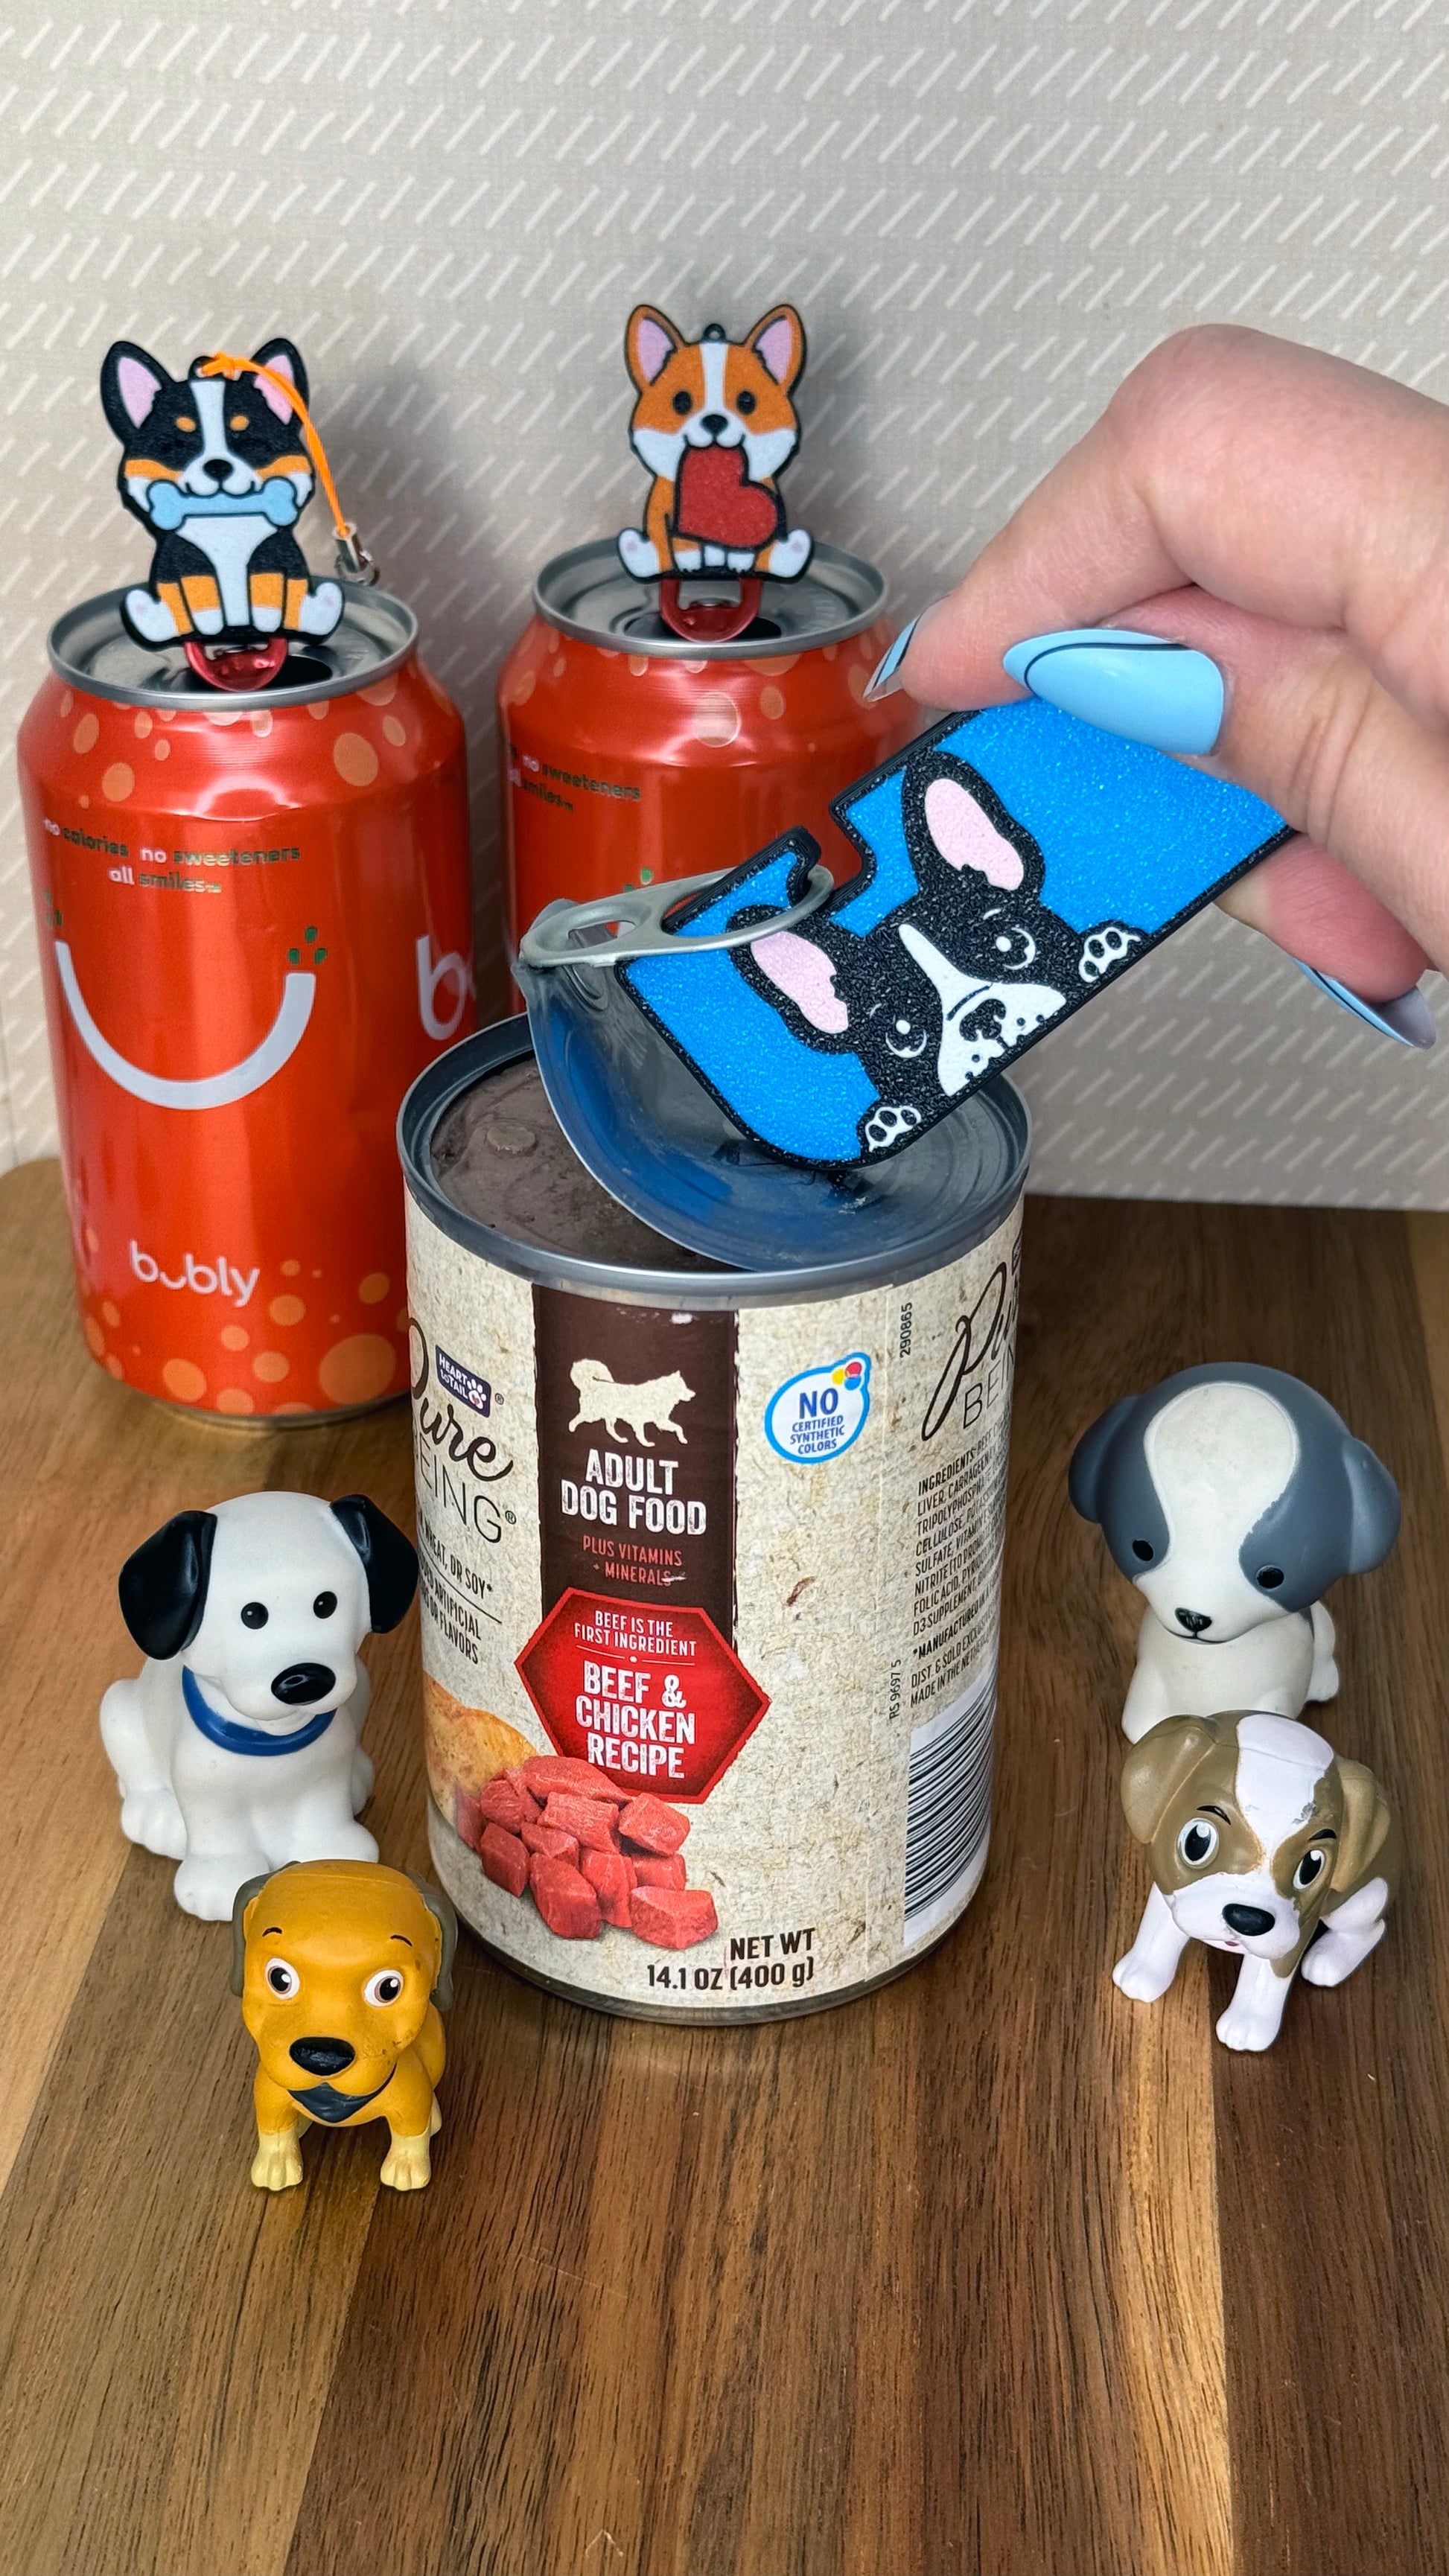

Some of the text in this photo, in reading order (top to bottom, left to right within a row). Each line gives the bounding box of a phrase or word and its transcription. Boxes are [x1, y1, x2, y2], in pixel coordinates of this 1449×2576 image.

[542, 765, 641, 801] sweeteners
[63, 828, 128, 857] calories
[140, 847, 167, 863] no
[173, 847, 299, 867] sweeteners
[108, 864, 135, 885] all
[899, 1302, 913, 1359] 290865
[439, 1353, 468, 1384] HEART
[799, 1388, 838, 1420] NO
[789, 1424, 845, 1445] SYNTHETIC
[792, 1415, 844, 1432] CERTIFIED
[797, 1438, 837, 1455] COLORS
[585, 1448, 679, 1495] ADULT
[561, 1479, 707, 1535] DOG FOOD
[917, 1490, 946, 1517] LIVER,
[583, 1534, 683, 1566] PLUS VITAMINS
[450, 1554, 462, 1584] OR
[605, 1561, 672, 1587] MINERALS
[914, 1564, 949, 1597] NITRITE
[434, 1577, 481, 1641] ARTIFICIAL
[914, 1590, 939, 1617] FOLIC
[439, 1610, 479, 1665] FLAVORS
[574, 1622, 697, 1657] FIRST INGREDIENT
[595, 1610, 673, 1638] BEEF IS THE
[913, 1617, 926, 1636] D3
[942, 1642, 961, 1668] SOLD
[584, 1660, 687, 1709] BEEF &
[890, 1672, 901, 1701] 9697
[911, 1680, 936, 1709] MADE
[937, 1672, 946, 1692] IN
[947, 1660, 961, 1683] THE
[575, 1695, 695, 1744] CHICKEN
[889, 1703, 900, 1720] RS
[587, 1732, 685, 1779] RECIPE
[730, 1927, 816, 1961] NET WT
[647, 1956, 815, 1991] 14.1 OZ (400 g)
